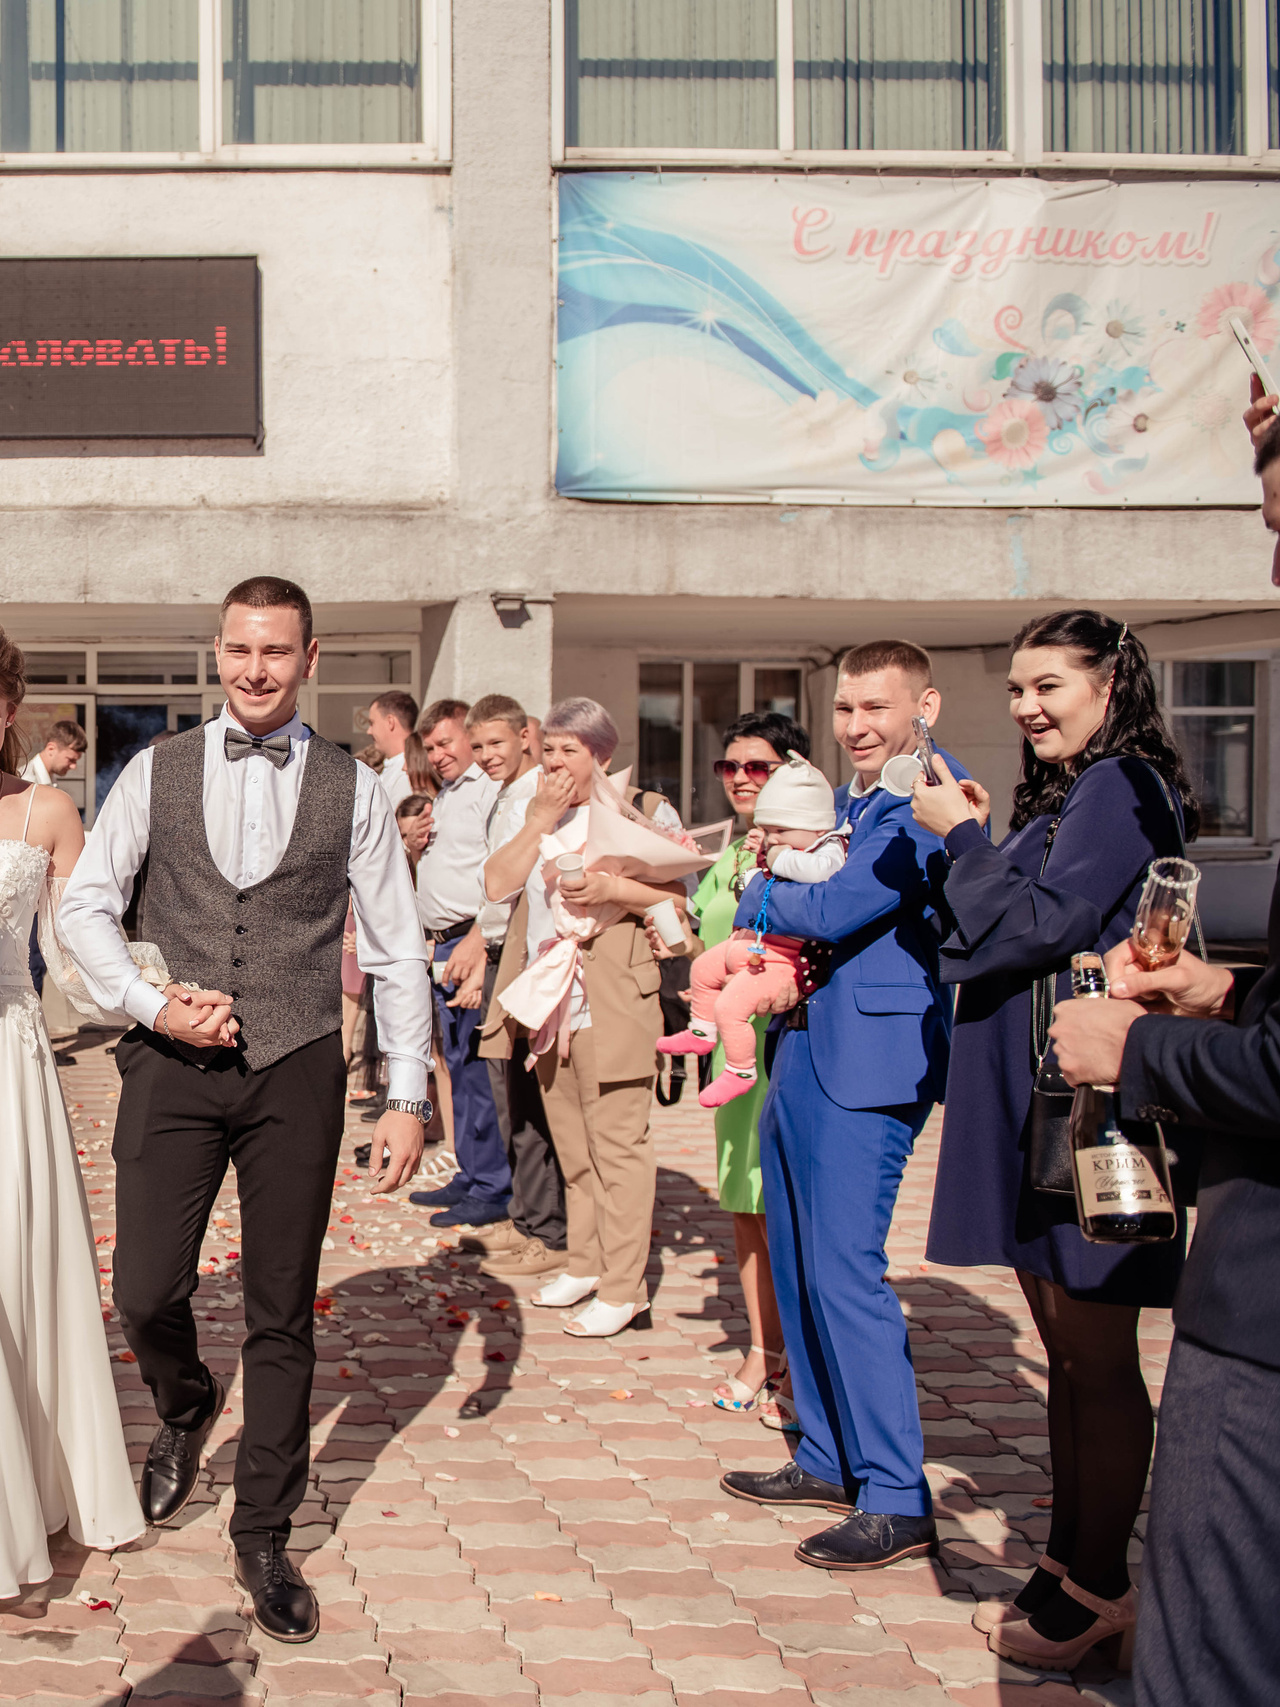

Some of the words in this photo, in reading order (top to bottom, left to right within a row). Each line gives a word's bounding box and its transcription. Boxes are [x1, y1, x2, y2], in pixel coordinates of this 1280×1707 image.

[792, 205, 830, 257] С
[847, 211, 1216, 274] праздником!
[1093, 1158, 1146, 1171] КРЫМ
